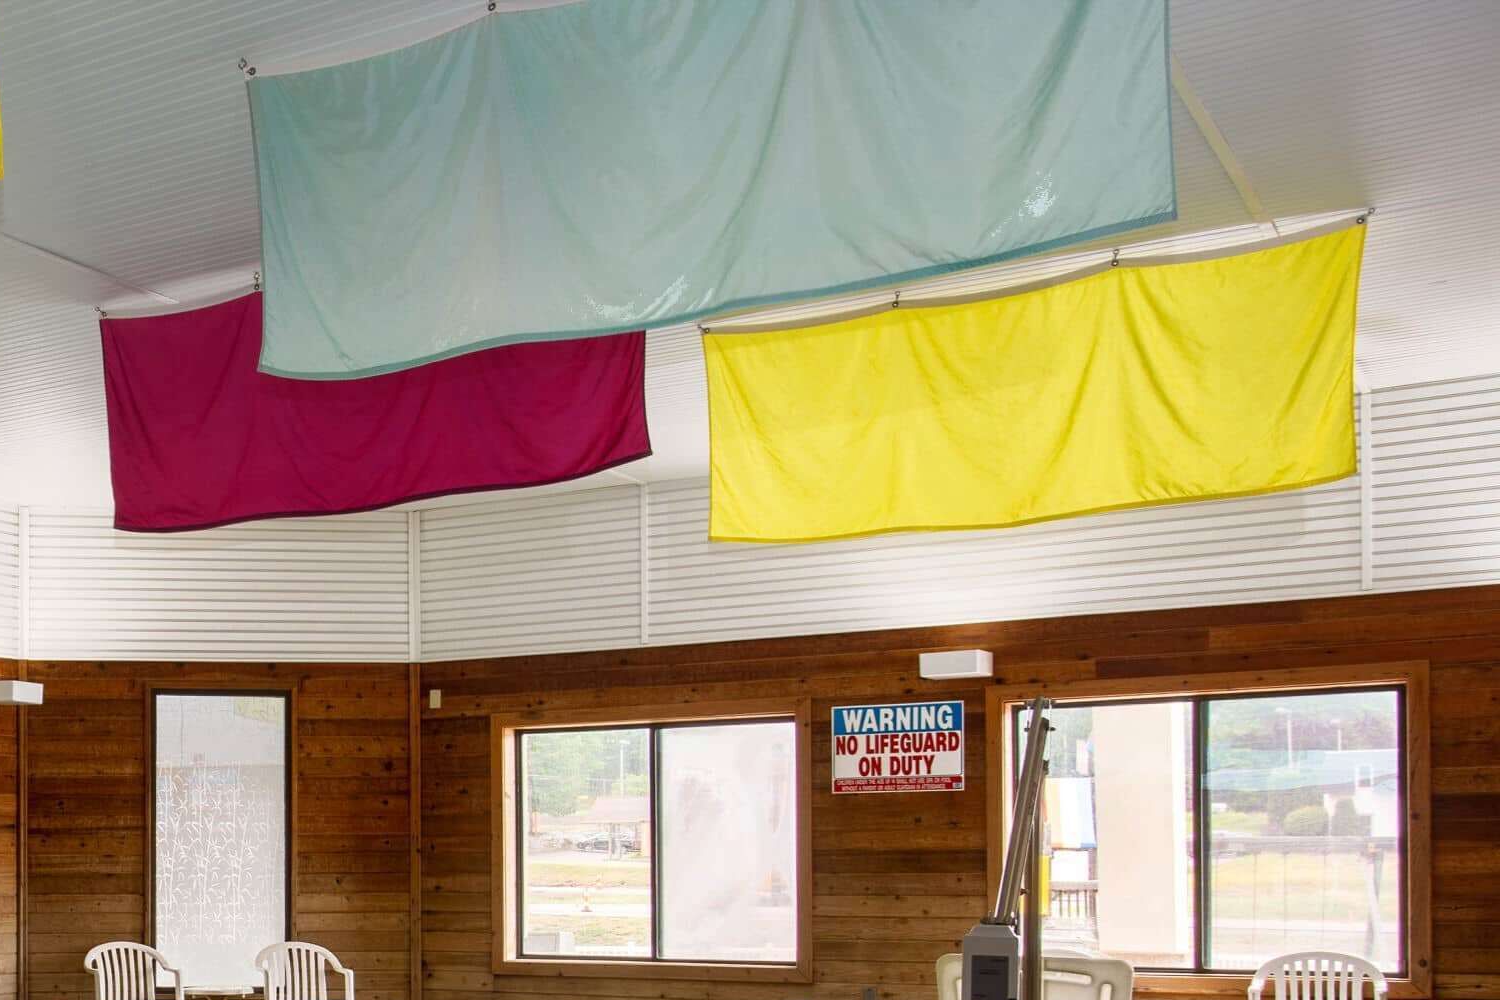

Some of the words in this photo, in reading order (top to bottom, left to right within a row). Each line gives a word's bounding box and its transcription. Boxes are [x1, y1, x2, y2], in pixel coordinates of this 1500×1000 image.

[842, 705, 953, 733] WARNING
[836, 735, 858, 755] NO
[866, 732, 960, 754] LIFEGUARD
[858, 757, 882, 776] ON
[890, 755, 935, 775] DUTY
